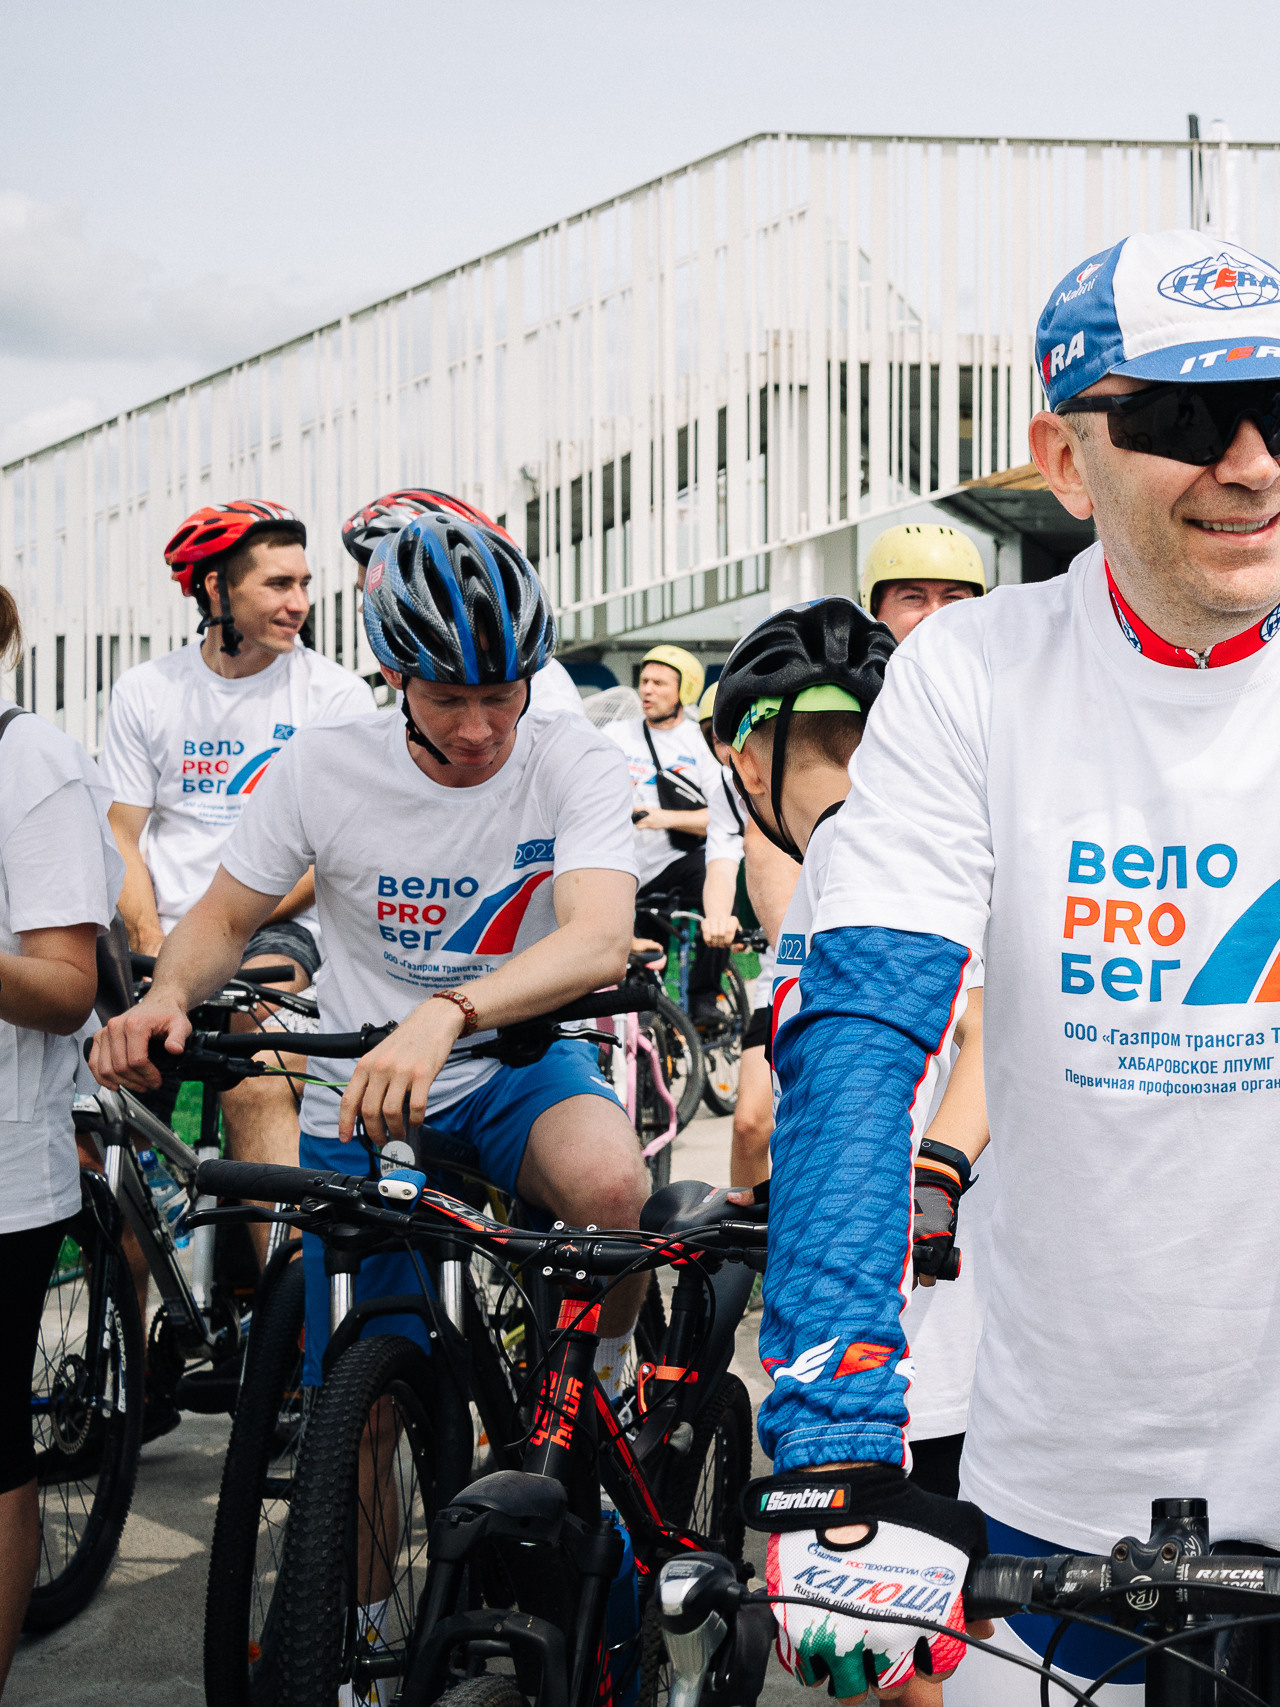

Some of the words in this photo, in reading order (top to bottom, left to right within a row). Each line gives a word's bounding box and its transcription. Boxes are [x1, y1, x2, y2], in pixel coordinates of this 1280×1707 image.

[1056, 274, 1098, 306] Nalini
[1173, 267, 1279, 294] ITERA
[182, 760, 229, 775] PRO
[377, 900, 447, 925] PRO
[1063, 896, 1186, 947] PRO
[1064, 1021, 1098, 1042] ООО
[1102, 1028, 1181, 1048] «Газпром
[1186, 1031, 1265, 1051] трансгаз
[1118, 1056, 1218, 1075] ХАБАРОВСКОЕ
[1223, 1056, 1275, 1074] ЛПУМГ
[1065, 1068, 1134, 1092] Первичная
[1138, 1079, 1237, 1097] профсоюзная
[766, 1489, 834, 1511] Santini
[793, 1565, 952, 1617] КАТЮША
